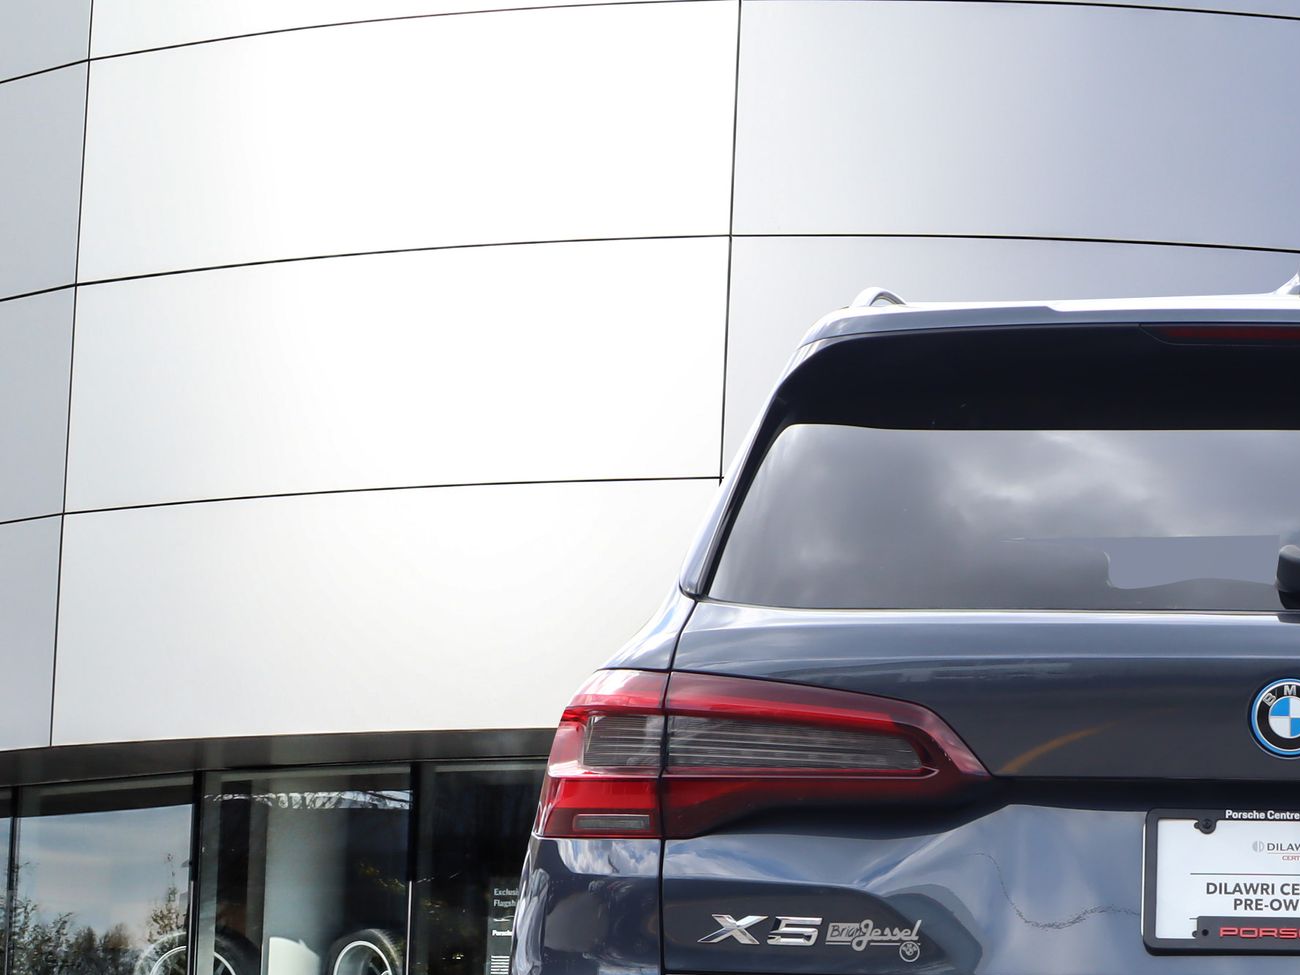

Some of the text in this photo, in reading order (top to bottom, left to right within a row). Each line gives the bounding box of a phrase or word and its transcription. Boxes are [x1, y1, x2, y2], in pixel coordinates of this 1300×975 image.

[1225, 809, 1266, 819] Porsche
[1267, 810, 1300, 820] Centre
[493, 888, 519, 896] Exclusi
[1206, 882, 1275, 896] DILAWRI
[493, 899, 516, 908] Flagsh
[830, 919, 922, 952] Brian Jessel
